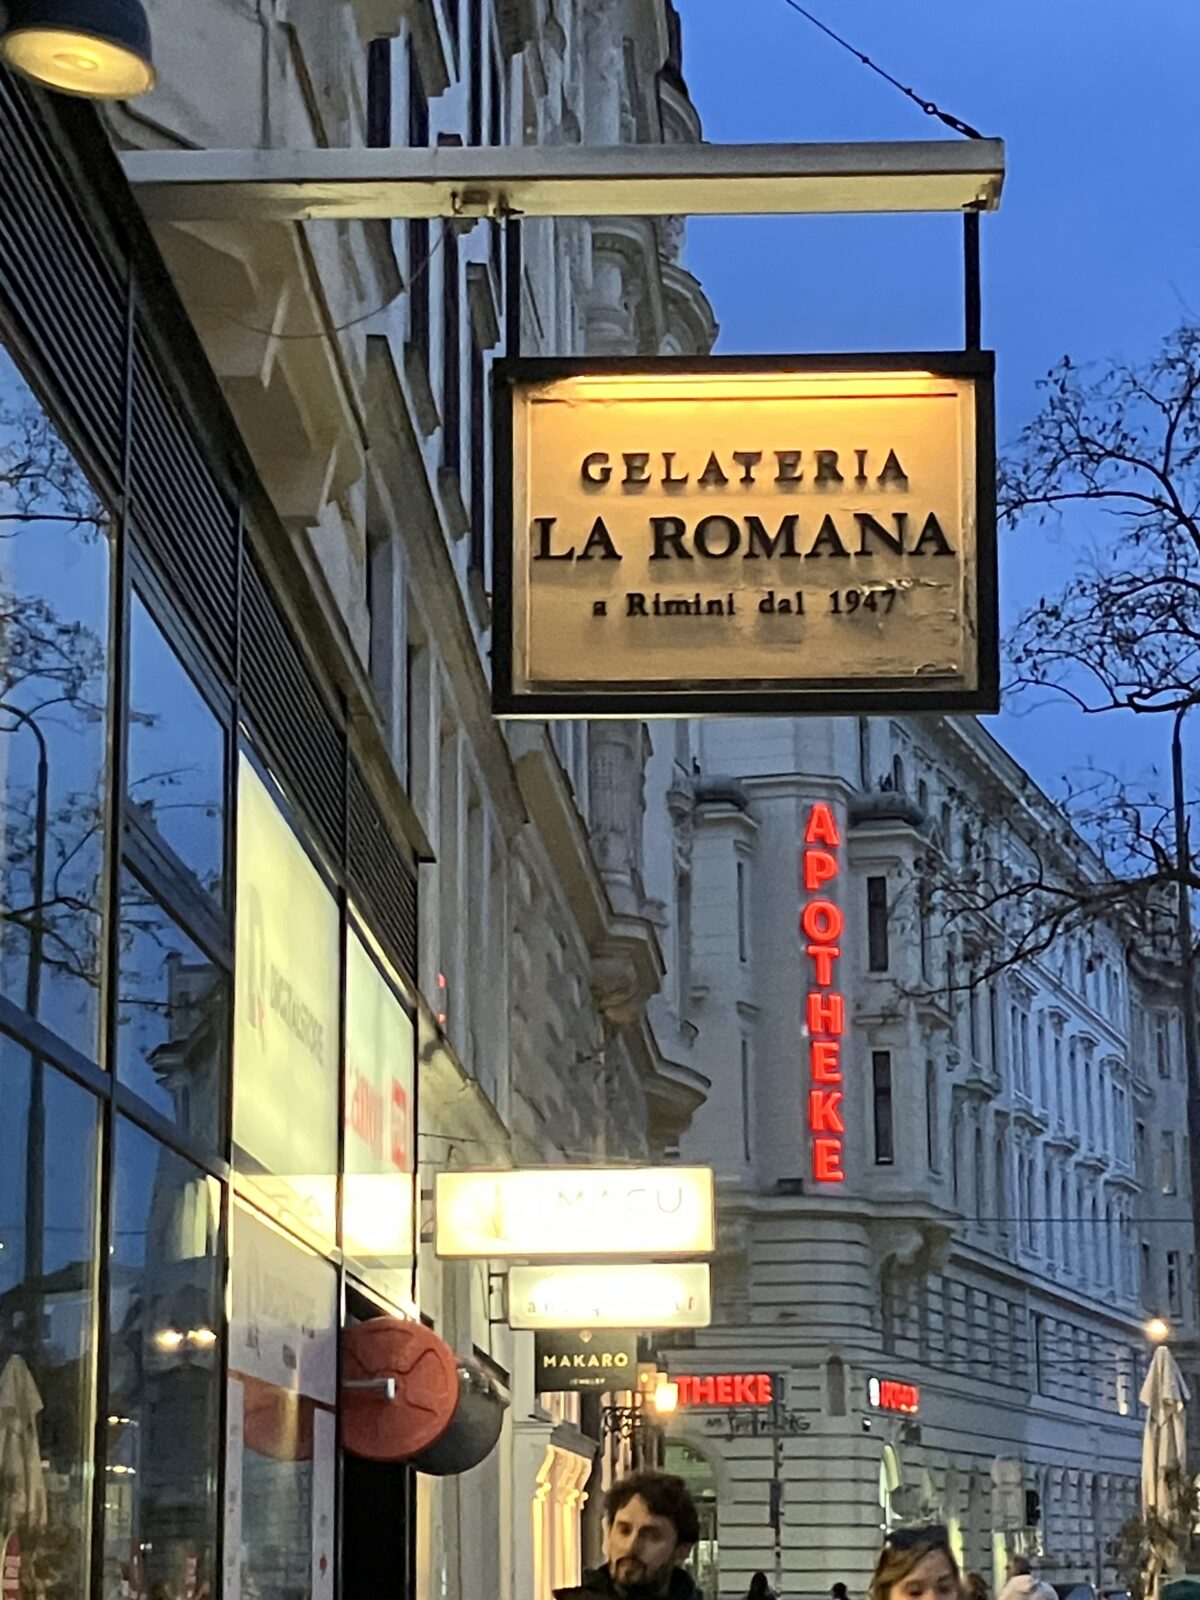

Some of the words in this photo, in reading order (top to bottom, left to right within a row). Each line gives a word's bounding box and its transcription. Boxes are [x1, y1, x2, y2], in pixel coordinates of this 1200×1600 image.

[581, 448, 908, 485] GELATERIA
[533, 515, 622, 561] LA
[649, 511, 956, 561] ROMANA
[592, 598, 607, 617] a
[626, 592, 736, 617] Rimini
[758, 590, 804, 616] dal
[829, 588, 896, 615] 1947
[801, 800, 845, 1183] APOTHEKE
[543, 1352, 629, 1368] MAKARO
